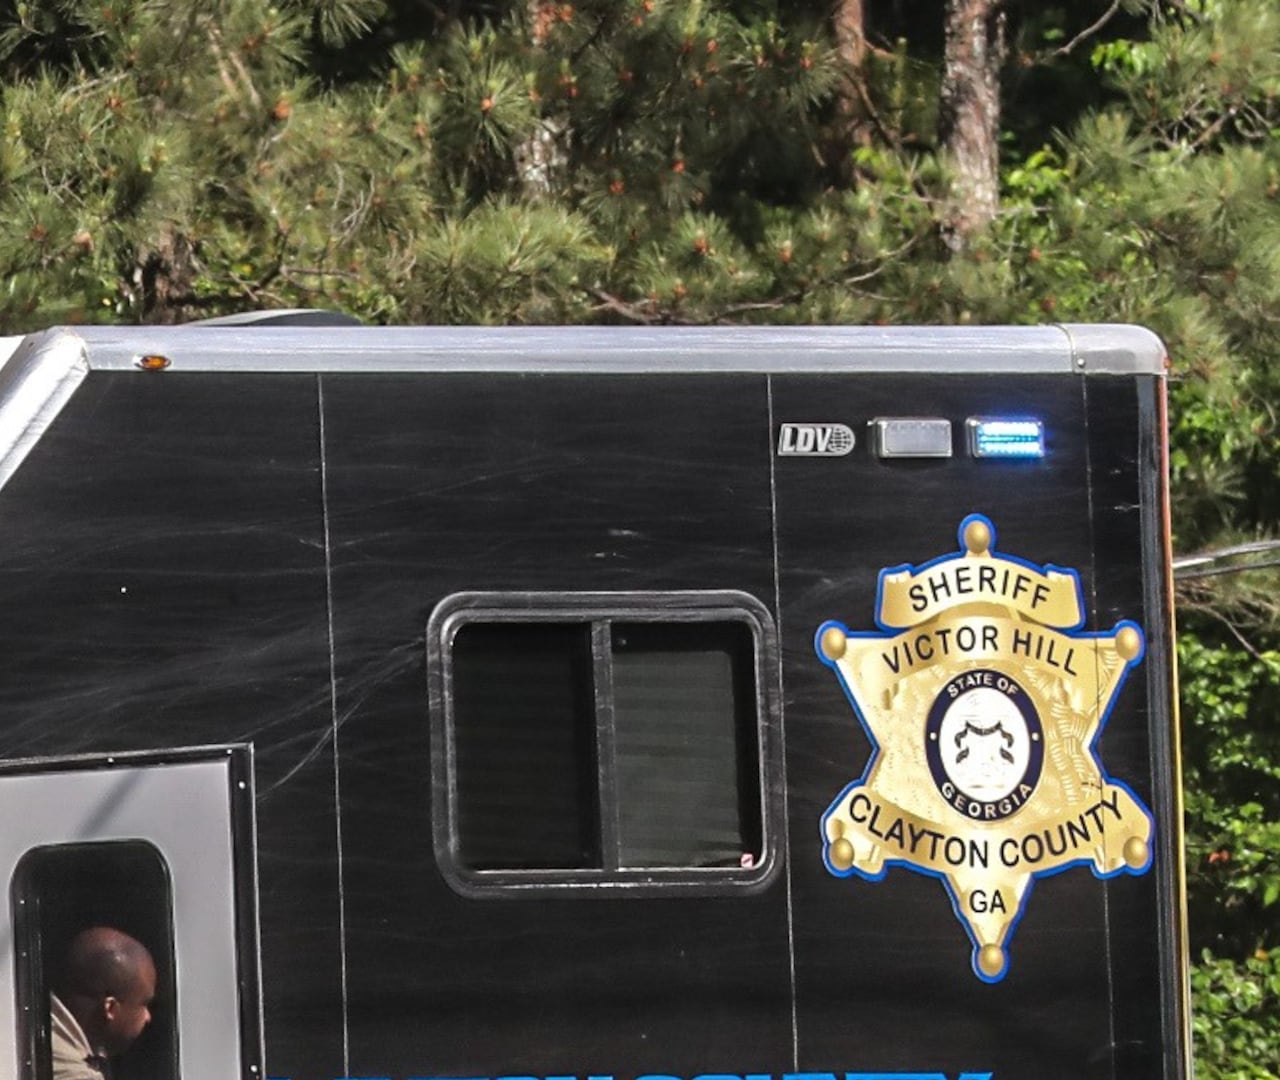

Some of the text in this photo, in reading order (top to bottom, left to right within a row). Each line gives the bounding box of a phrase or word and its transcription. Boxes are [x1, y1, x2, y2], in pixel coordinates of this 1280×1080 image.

[783, 427, 832, 452] LDV
[908, 565, 1051, 612] SHERIFF
[882, 625, 1078, 677] VICTOR HILL
[947, 672, 1019, 699] STATE OF
[941, 782, 1033, 819] GEORGIA
[848, 791, 1123, 868] CLAYTON COUNTY
[969, 890, 1007, 914] GA
